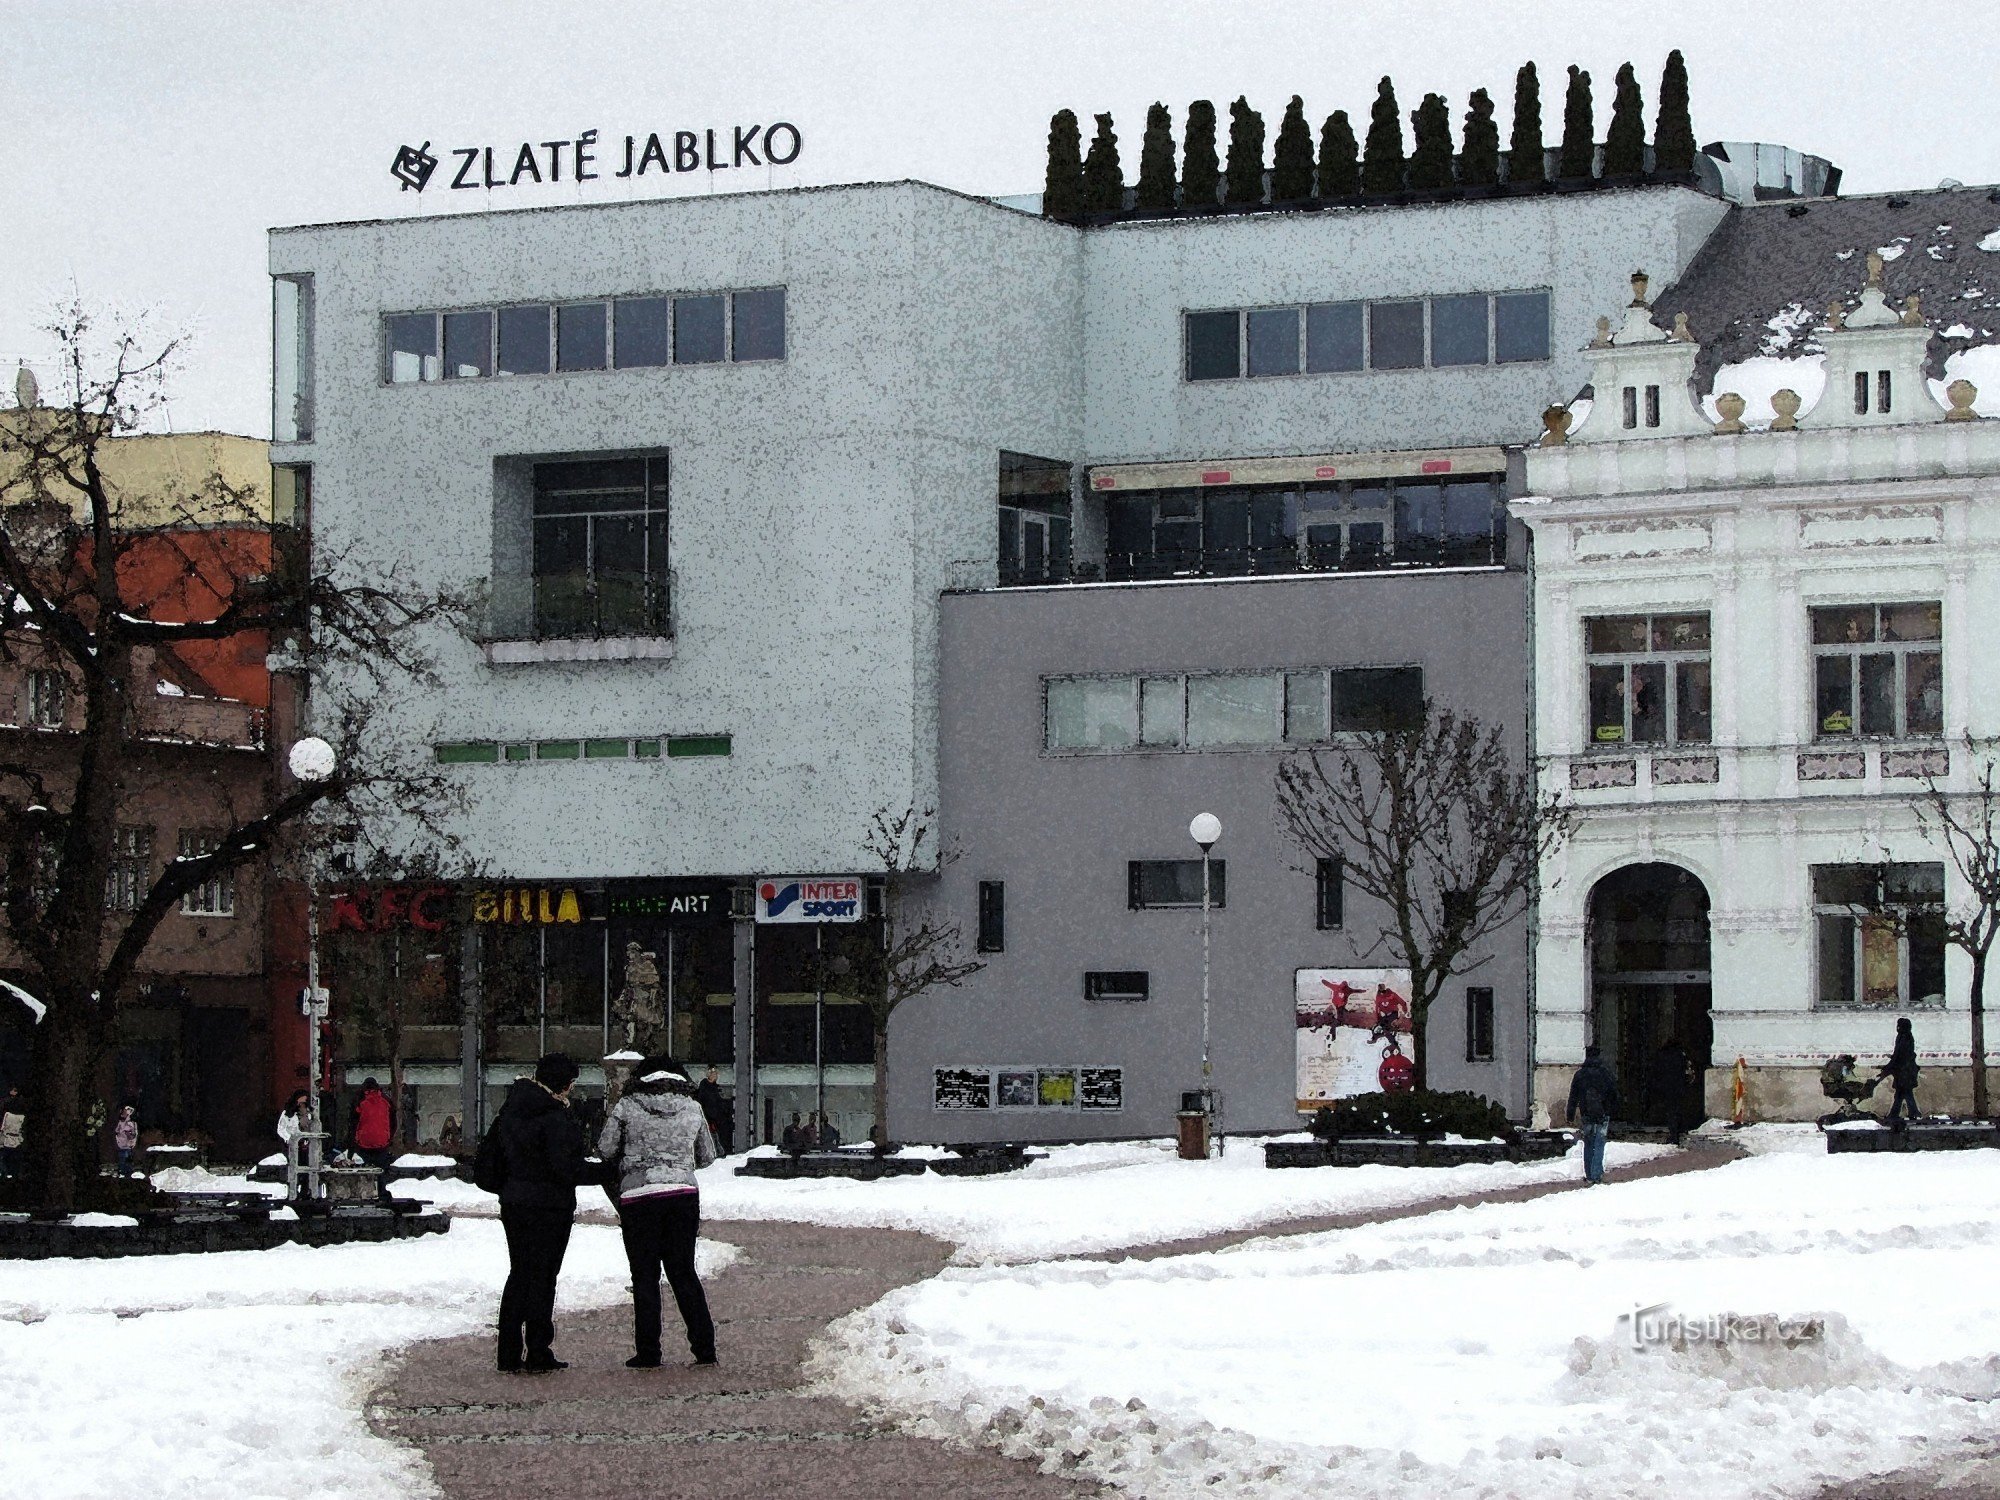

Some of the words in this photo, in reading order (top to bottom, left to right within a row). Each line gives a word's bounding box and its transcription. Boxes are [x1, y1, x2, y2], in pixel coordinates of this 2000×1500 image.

[451, 129, 599, 189] ZLATÉ
[615, 121, 802, 178] JABLKO
[802, 882, 859, 900] INTER
[802, 900, 858, 917] SPORT
